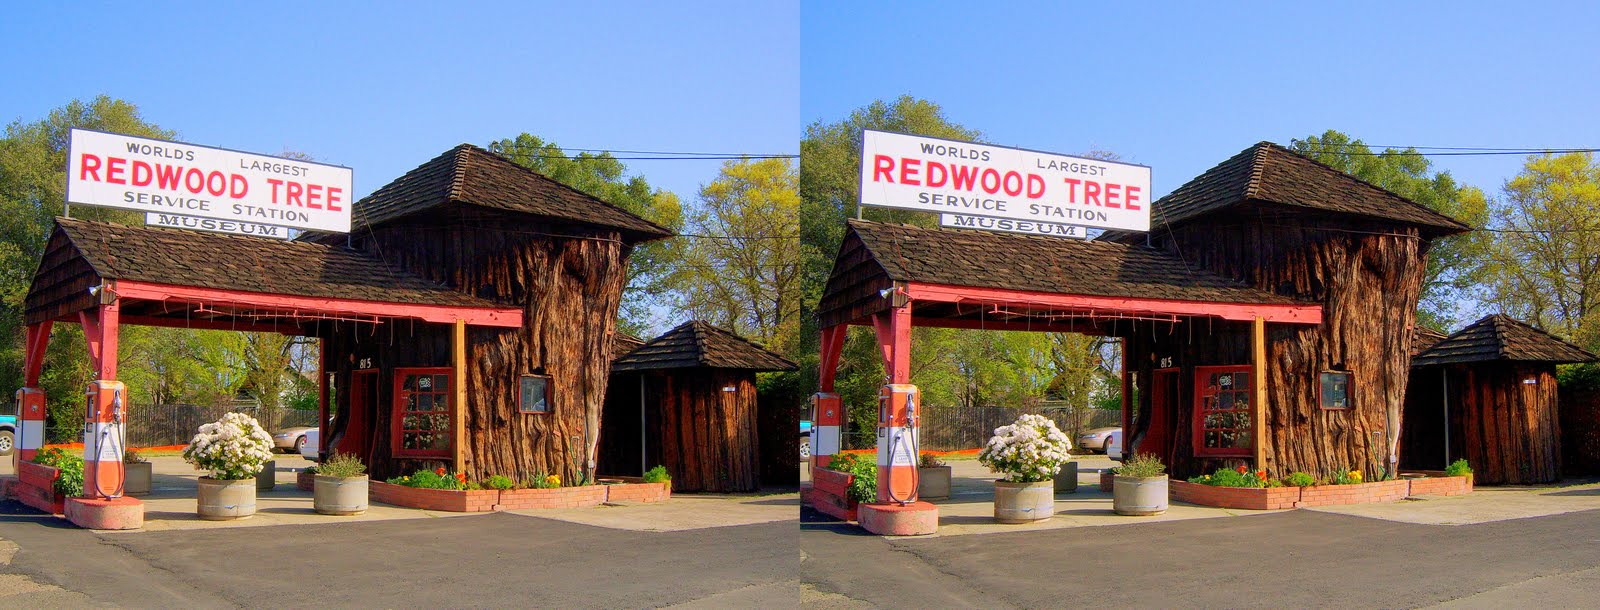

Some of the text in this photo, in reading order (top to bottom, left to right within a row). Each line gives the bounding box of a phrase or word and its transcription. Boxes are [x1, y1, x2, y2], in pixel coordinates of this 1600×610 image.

[126, 142, 309, 177] WORLDS LARGEST
[920, 142, 1107, 177] WORLDS LARGEST
[80, 153, 342, 211] REDWOOD TREE
[873, 154, 1141, 211] REDWOOD TREE
[124, 191, 309, 223] SERVICE STATION
[918, 192, 1108, 222] SERVICE STATION
[158, 214, 278, 236] MUSEUM
[954, 214, 1076, 236] MUSEUM
[359, 357, 372, 369] 815
[1160, 356, 1172, 368] 815
